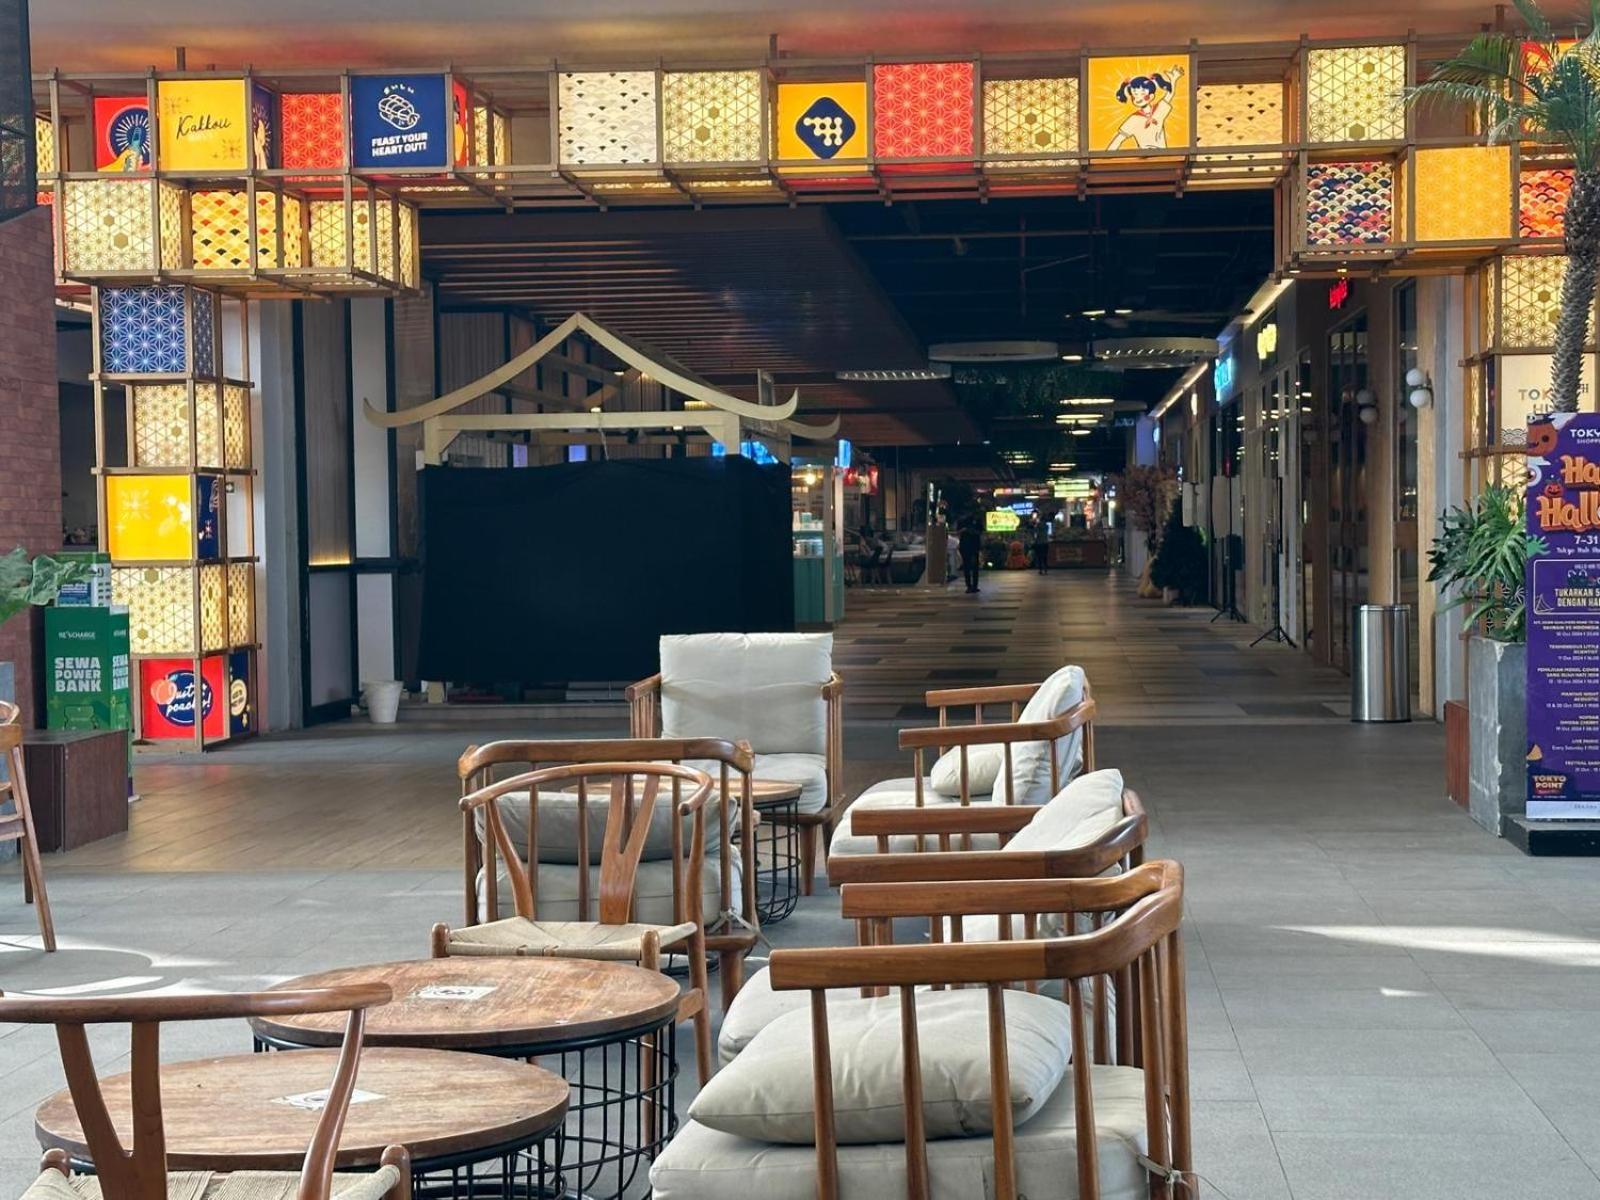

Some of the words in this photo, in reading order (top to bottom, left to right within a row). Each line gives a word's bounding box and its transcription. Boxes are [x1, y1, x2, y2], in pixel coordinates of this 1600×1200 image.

[372, 135, 402, 148] FEAST
[402, 132, 429, 145] YOUR
[372, 144, 405, 157] HEART
[404, 141, 427, 153] OUT!
[1536, 491, 1600, 529] Hall
[55, 656, 101, 670] SEWA
[55, 669, 101, 680] POWER
[56, 680, 102, 692] BANK
